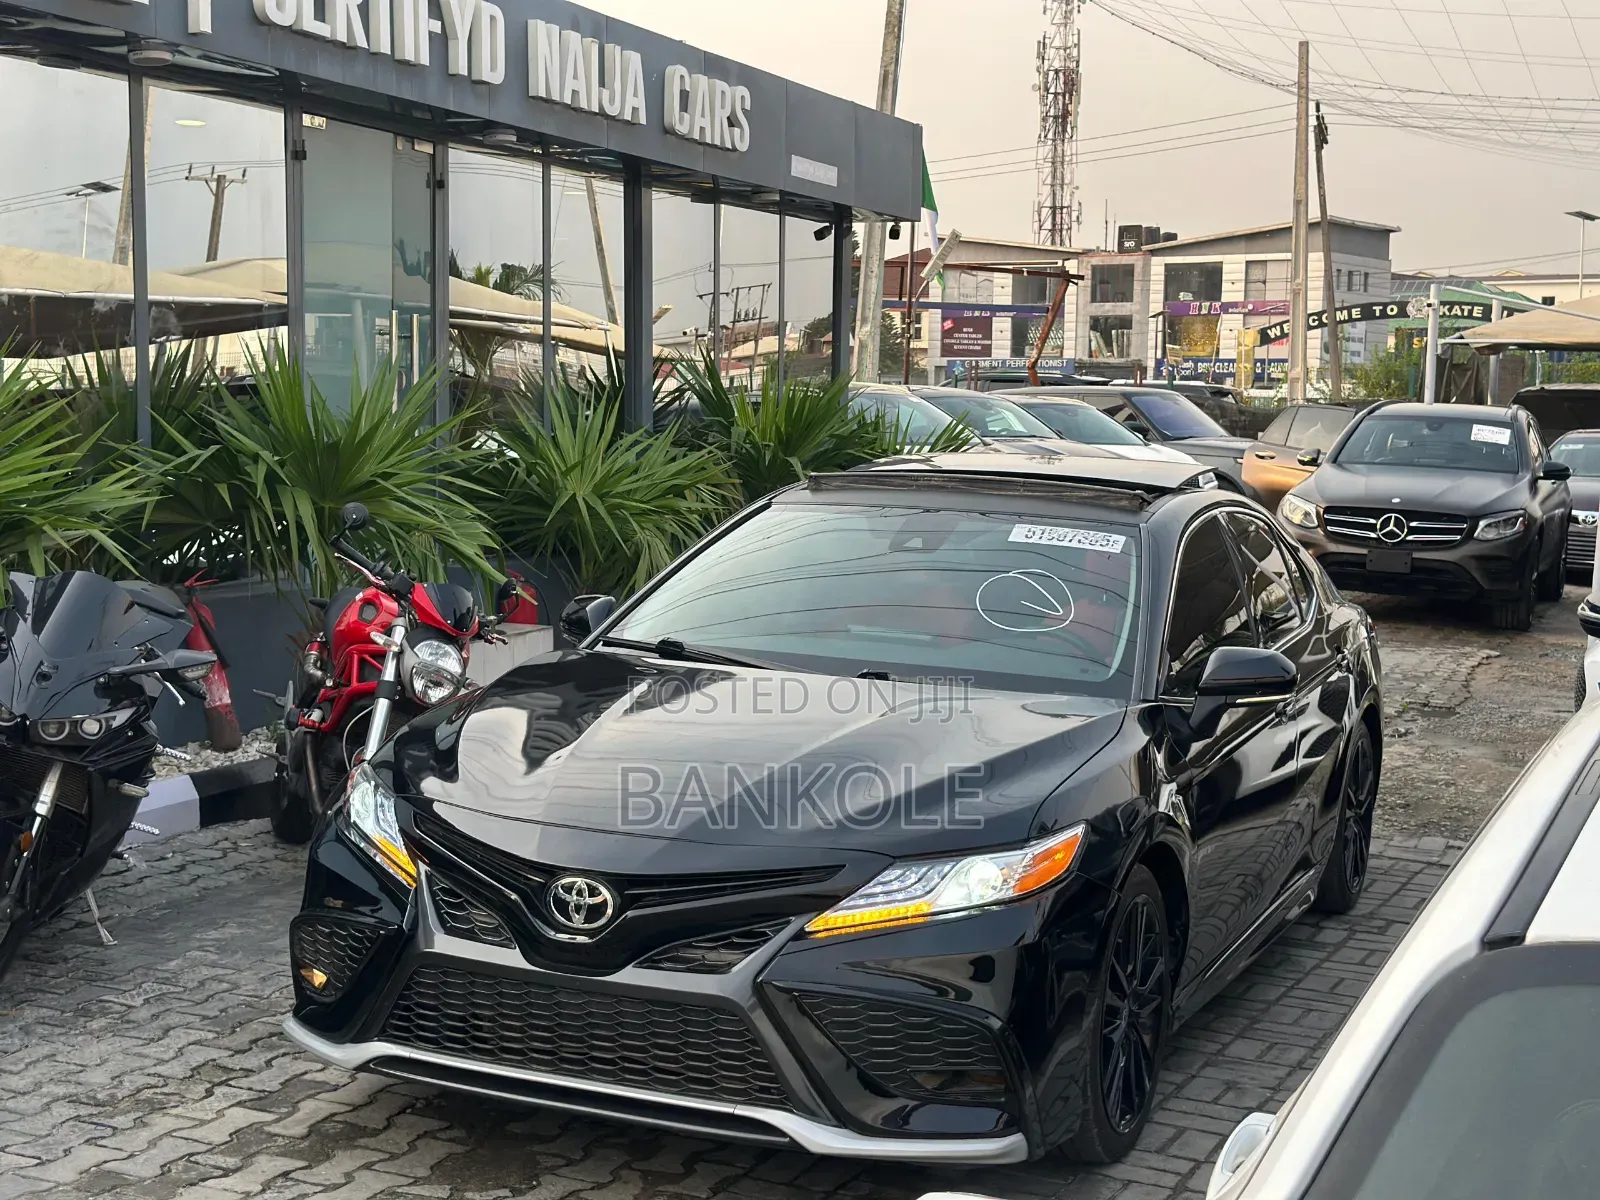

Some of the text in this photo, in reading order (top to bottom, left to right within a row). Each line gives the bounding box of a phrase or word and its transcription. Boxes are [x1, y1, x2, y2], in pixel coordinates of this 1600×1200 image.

[527, 18, 647, 126] NAIJA
[664, 63, 750, 152] CARS
[1266, 307, 1362, 340] WECOME
[1373, 304, 1399, 317] TO
